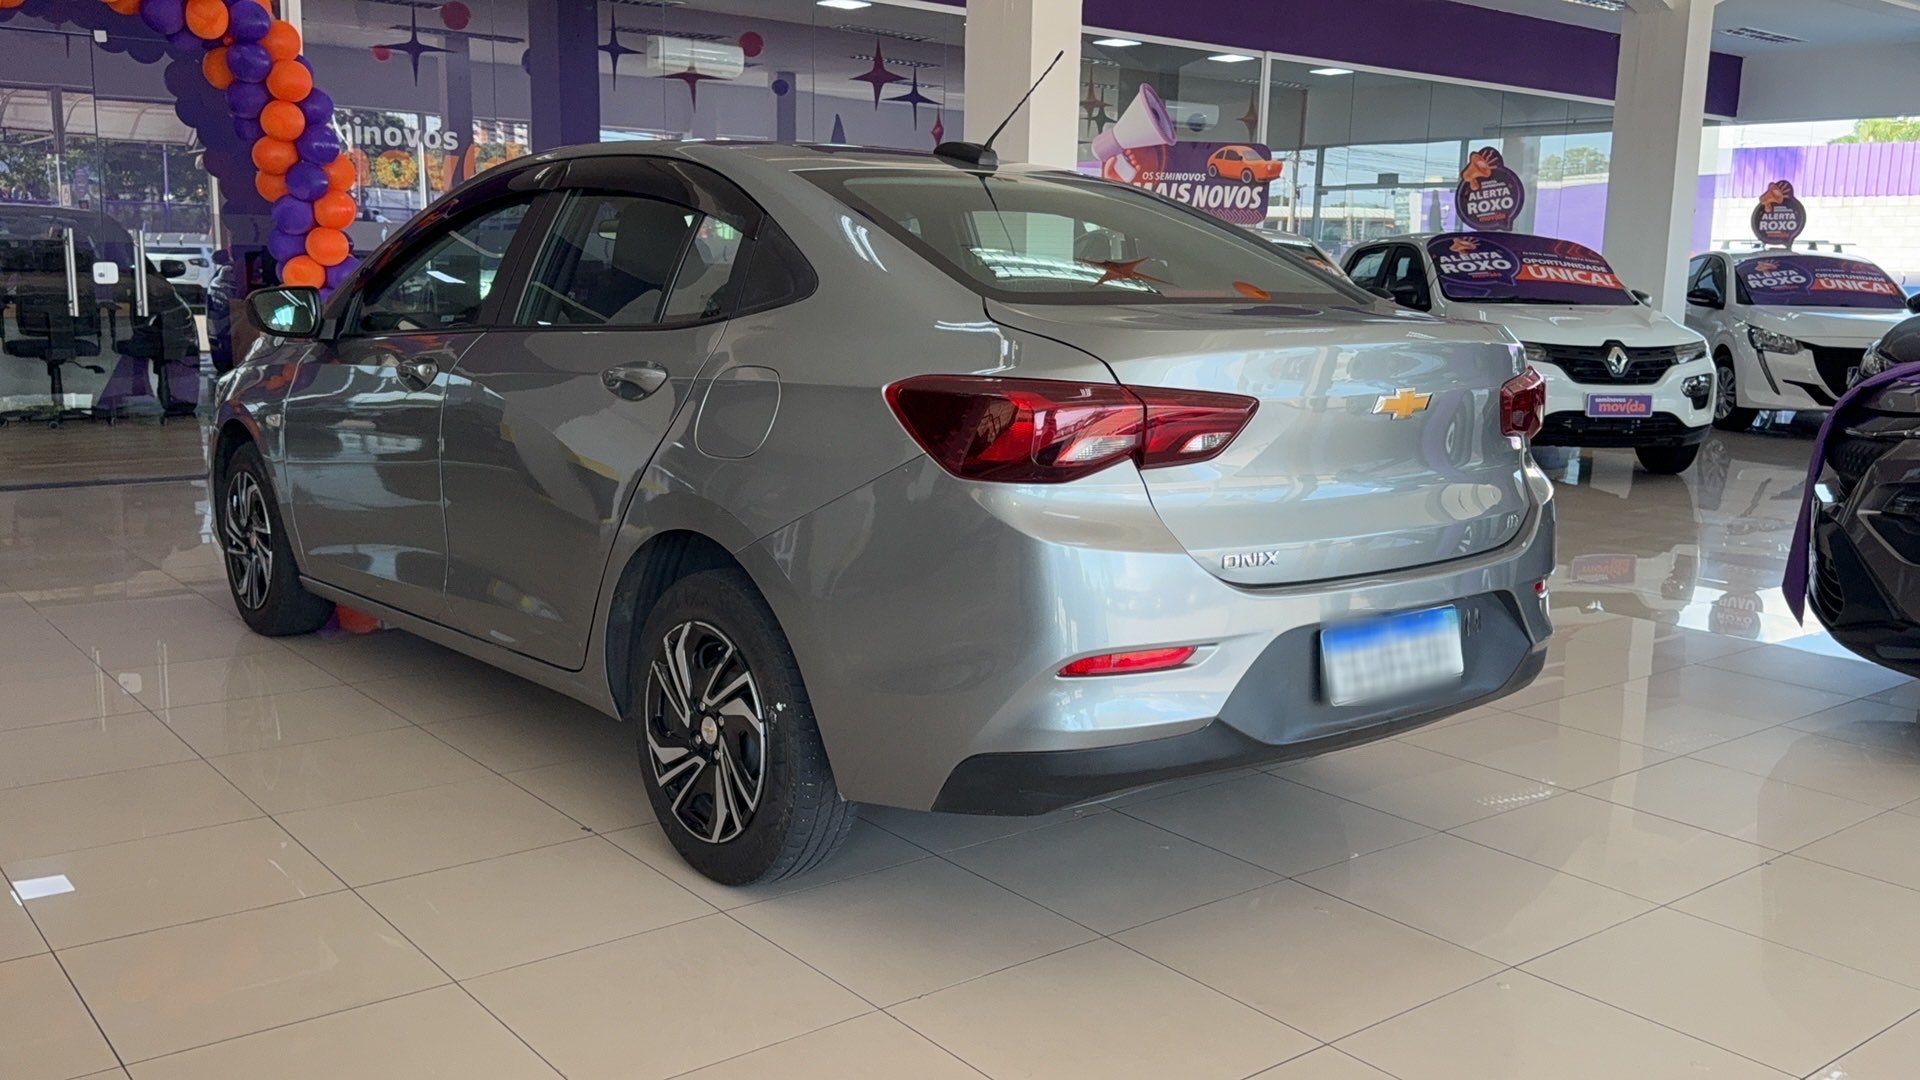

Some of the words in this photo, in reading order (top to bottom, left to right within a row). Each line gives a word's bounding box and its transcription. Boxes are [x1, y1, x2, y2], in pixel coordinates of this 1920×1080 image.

[1142, 171, 1154, 181] OS
[1155, 172, 1206, 181] SEMINOVOS
[1191, 185, 1264, 209] NOVOS
[1468, 187, 1511, 201] ALERTA
[1467, 196, 1514, 215] ROXO
[1759, 220, 1798, 231] ROXO
[1440, 251, 1503, 263] ALERTA
[1440, 259, 1512, 274] ROXO
[1522, 258, 1608, 273] OPORTUNIDADE
[1527, 264, 1615, 287] ÚNICA!
[1747, 269, 1799, 280] ALERTA
[1748, 275, 1807, 289] ROXO
[1599, 399, 1646, 414] movida
[1222, 550, 1280, 570] ONIX
